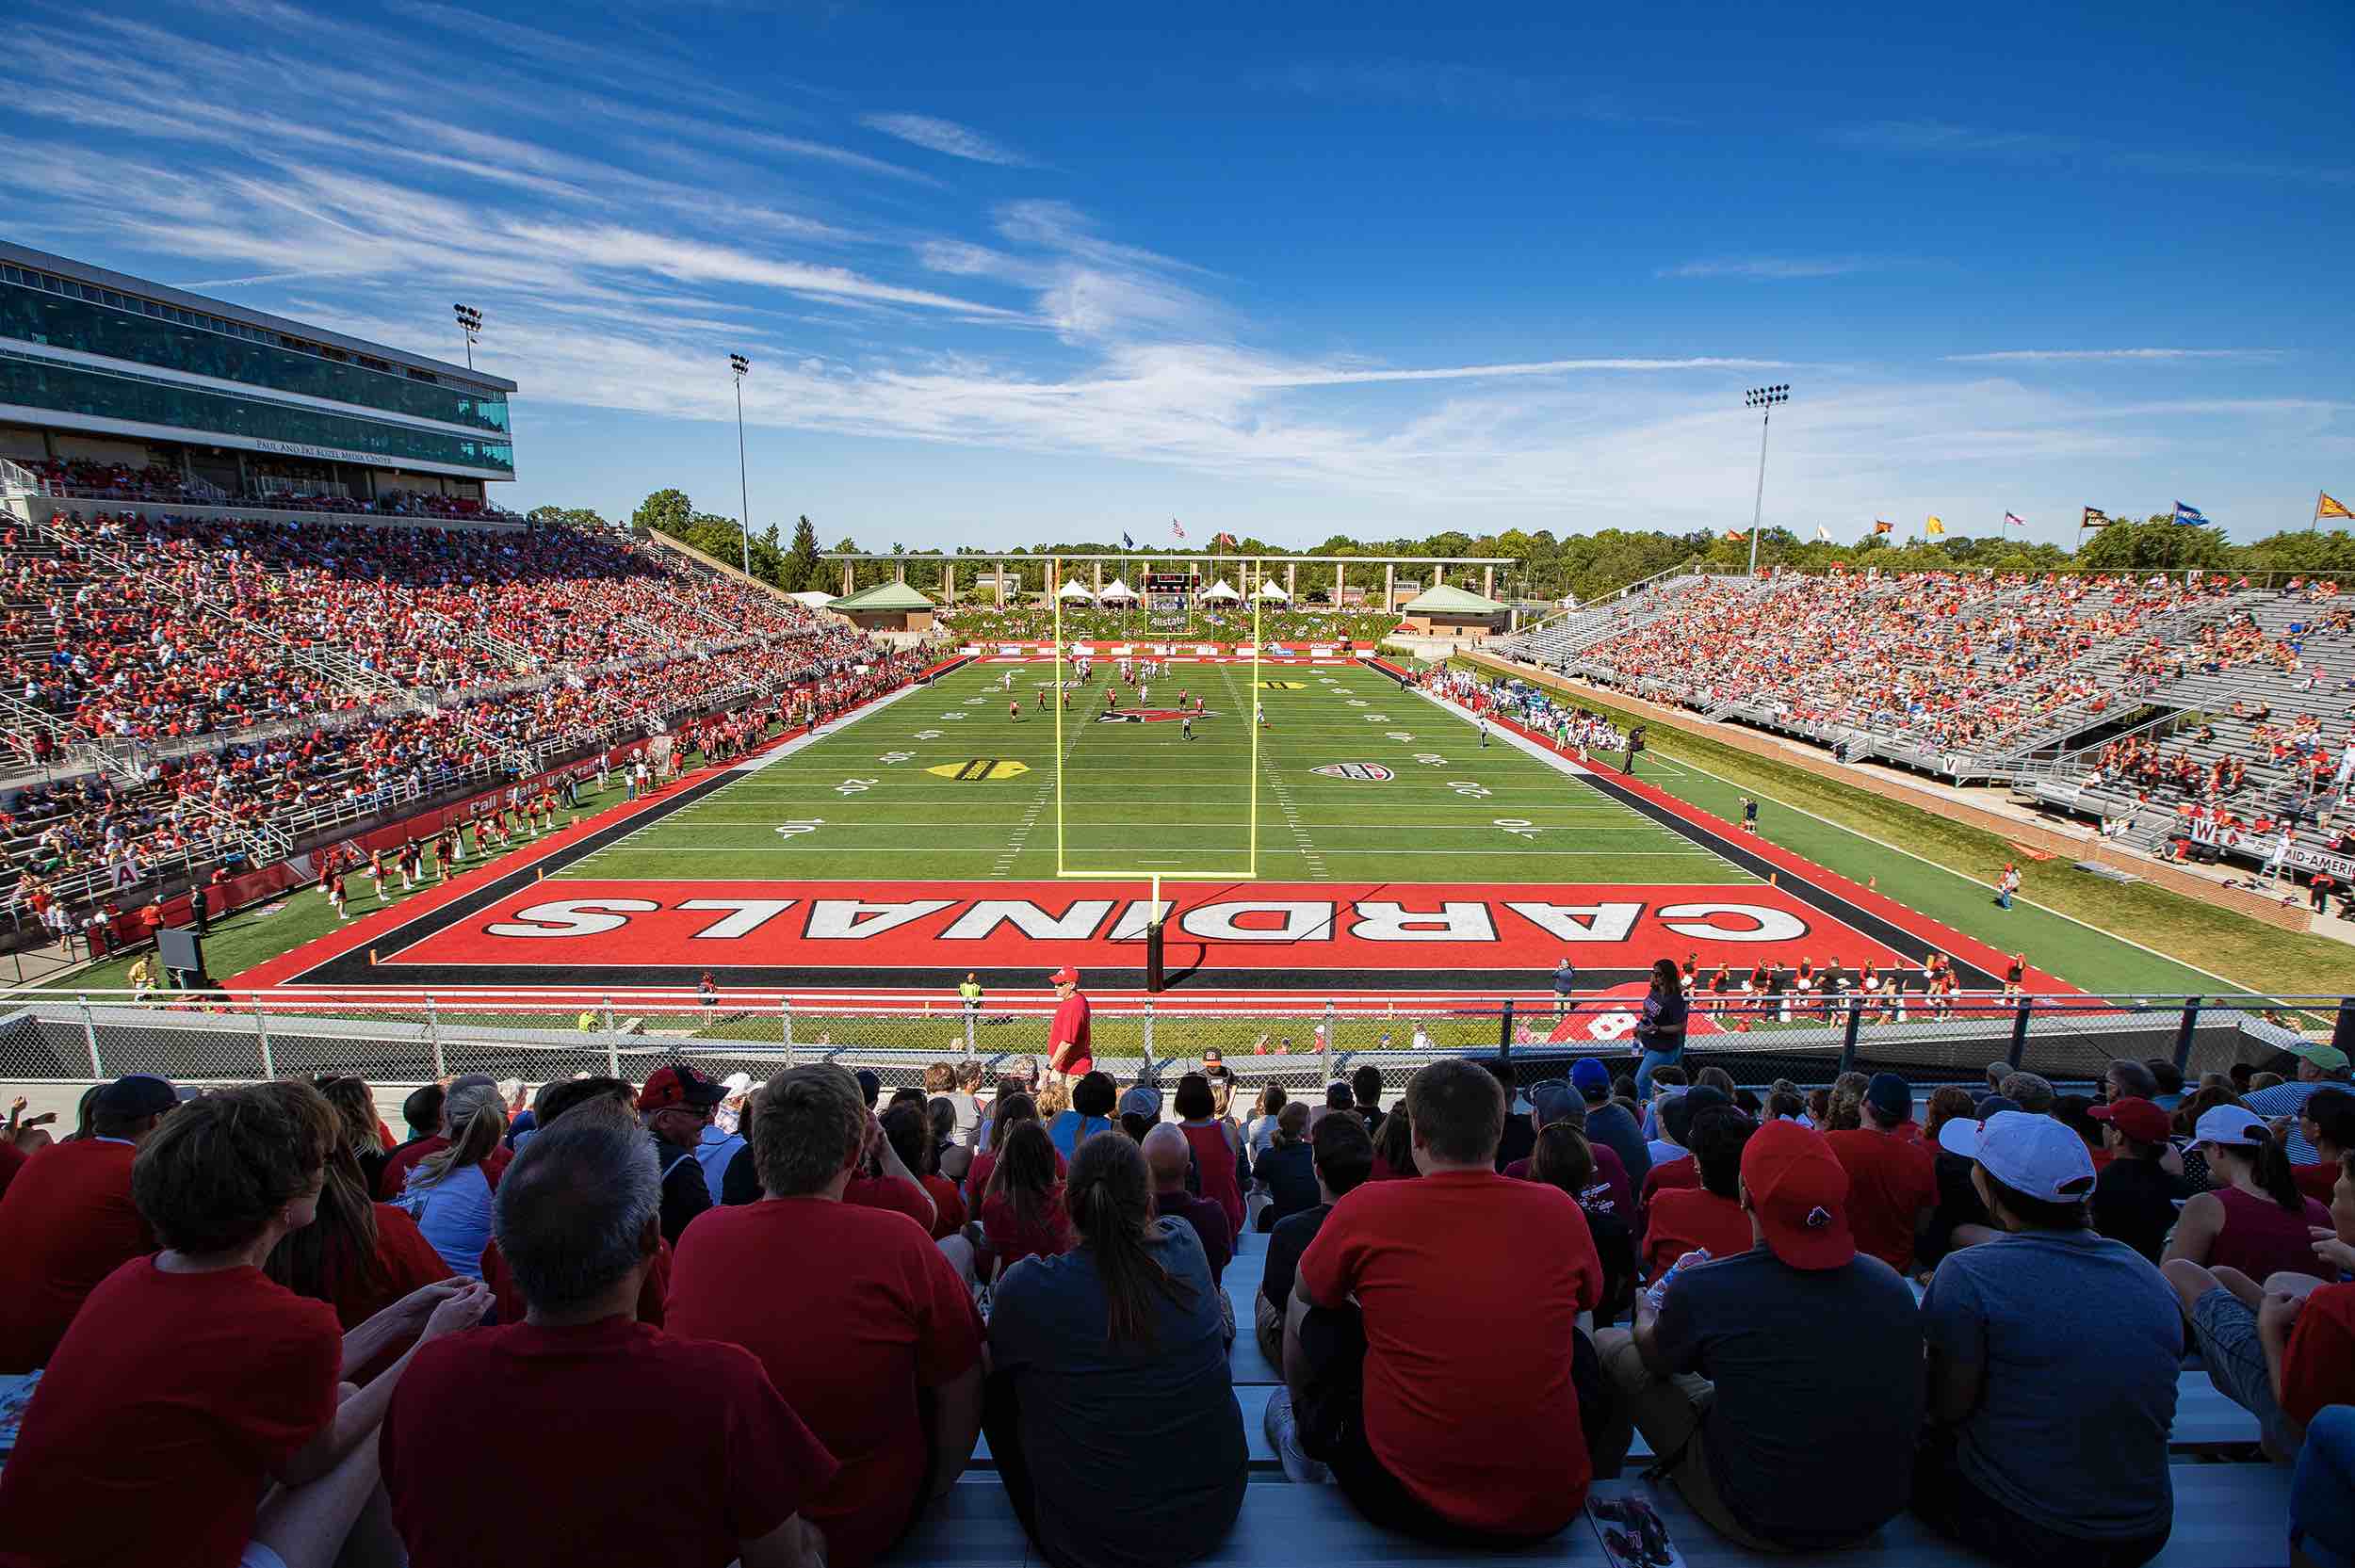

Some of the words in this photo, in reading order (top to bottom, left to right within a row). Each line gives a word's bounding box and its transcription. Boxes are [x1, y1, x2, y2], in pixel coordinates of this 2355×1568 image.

[255, 439, 280, 450] PAUL
[282, 443, 300, 453] AND
[1149, 617, 1186, 626] Allstate
[1171, 641, 1212, 650] University
[409, 782, 417, 797] B
[834, 778, 880, 794] 20
[1446, 781, 1493, 797] 20
[774, 817, 826, 835] 10
[1492, 818, 1543, 835] 10
[2197, 820, 2215, 840] W
[119, 867, 137, 886] A
[482, 897, 1812, 943] CARDINALS
